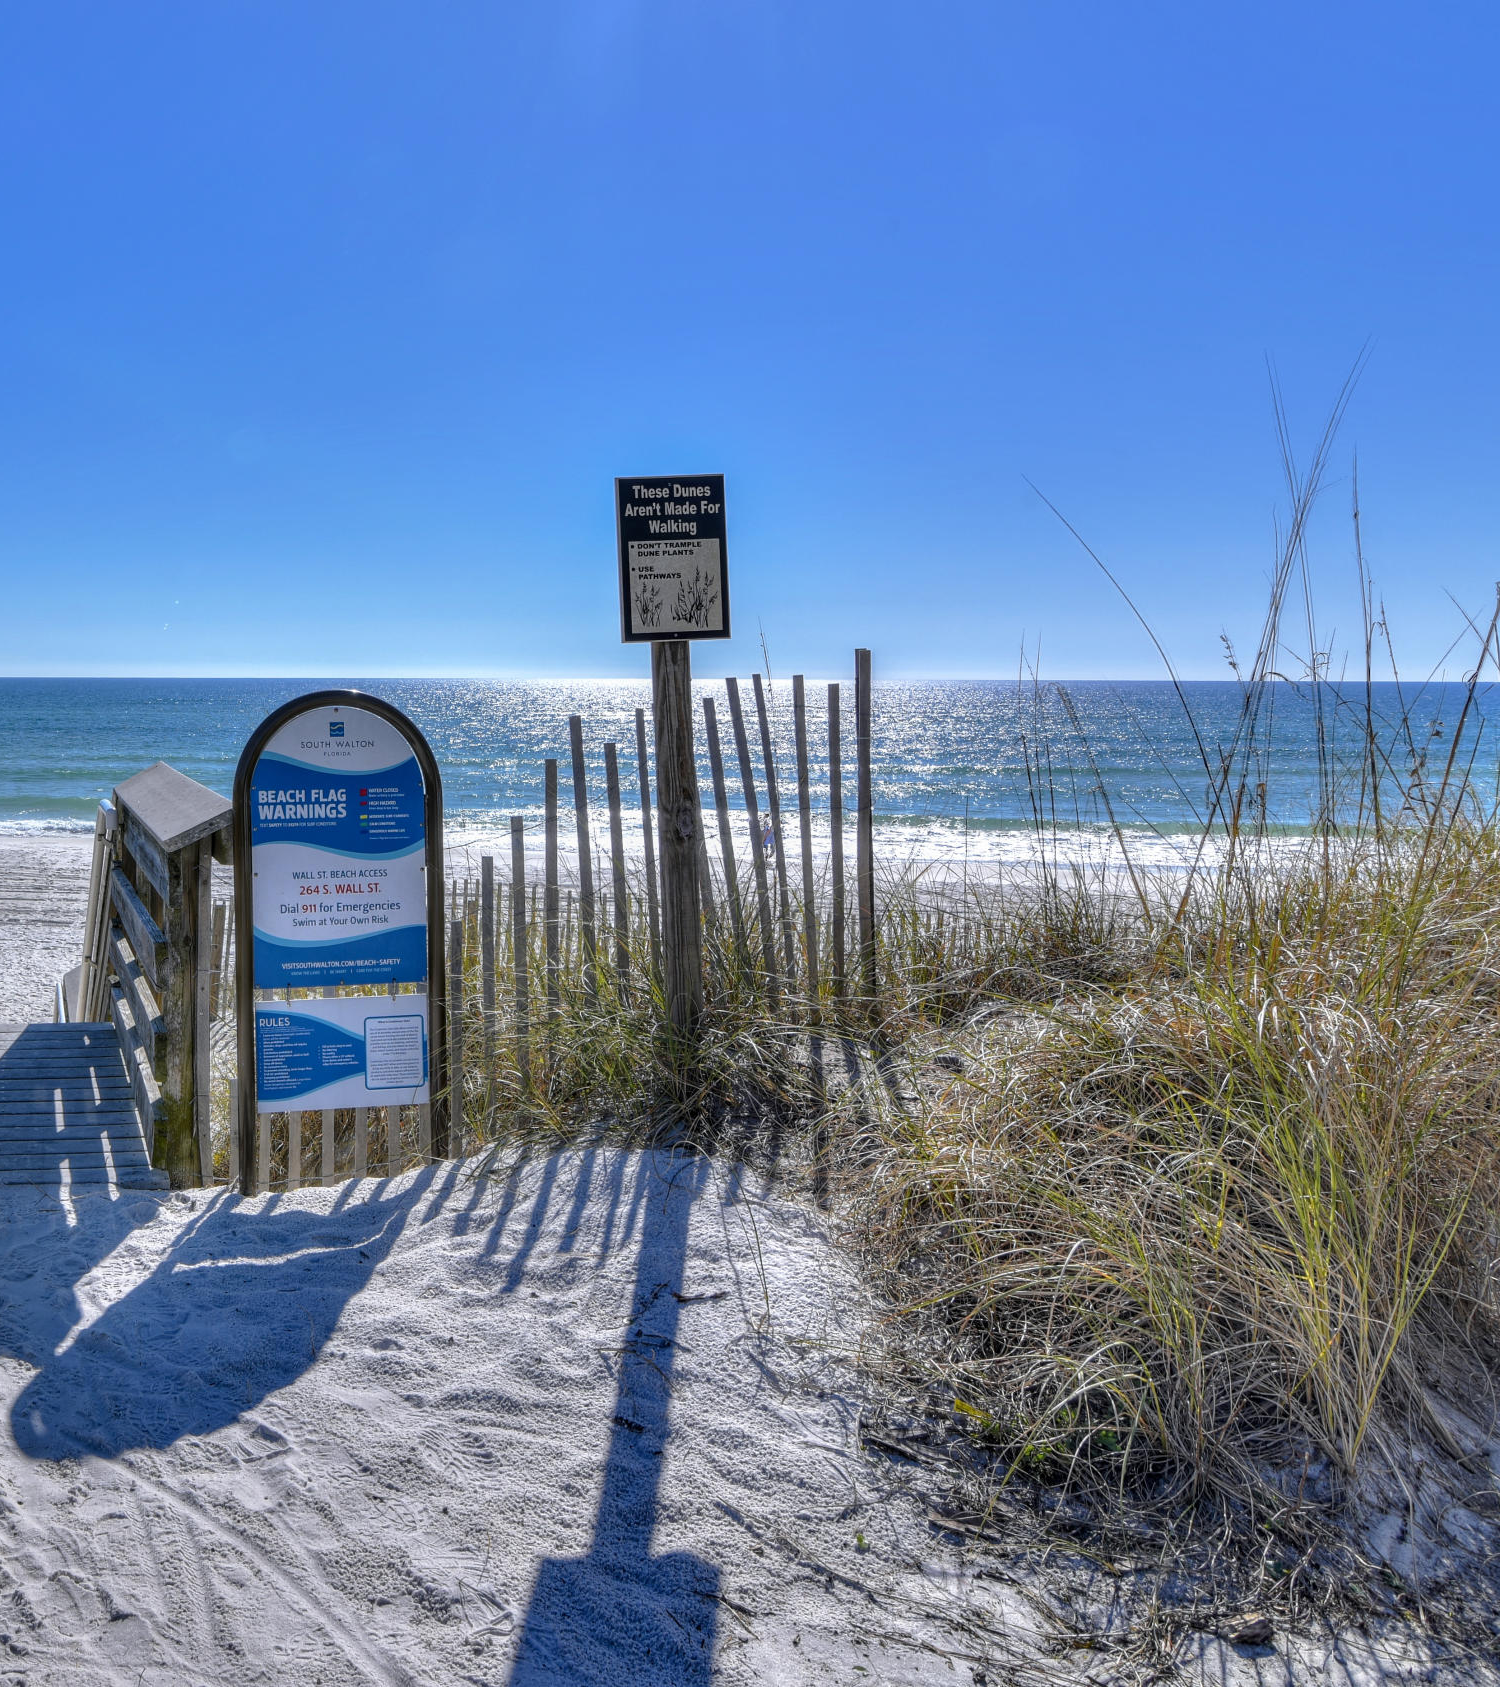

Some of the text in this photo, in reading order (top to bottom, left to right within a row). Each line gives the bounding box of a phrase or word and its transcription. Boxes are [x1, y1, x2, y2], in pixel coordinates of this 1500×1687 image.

[632, 483, 711, 499] These Dunes
[625, 501, 721, 517] Aren't Made For
[649, 519, 697, 535] Walking
[300, 740, 374, 749] SOUTH WALTON
[258, 788, 347, 803] BEACH FLAG
[258, 803, 347, 820] WARNINGS
[292, 869, 388, 880] WALL ST. BEACH ACCESS
[299, 883, 381, 895] 264 S. WALL ST.
[280, 900, 401, 914] Dial 911 for Emergencies
[292, 915, 389, 927] Swim at Your Own Risk
[281, 958, 400, 970] VISITSOUTHWALTON.COM/BEACH-SAFETY
[259, 1017, 291, 1027] RULES
